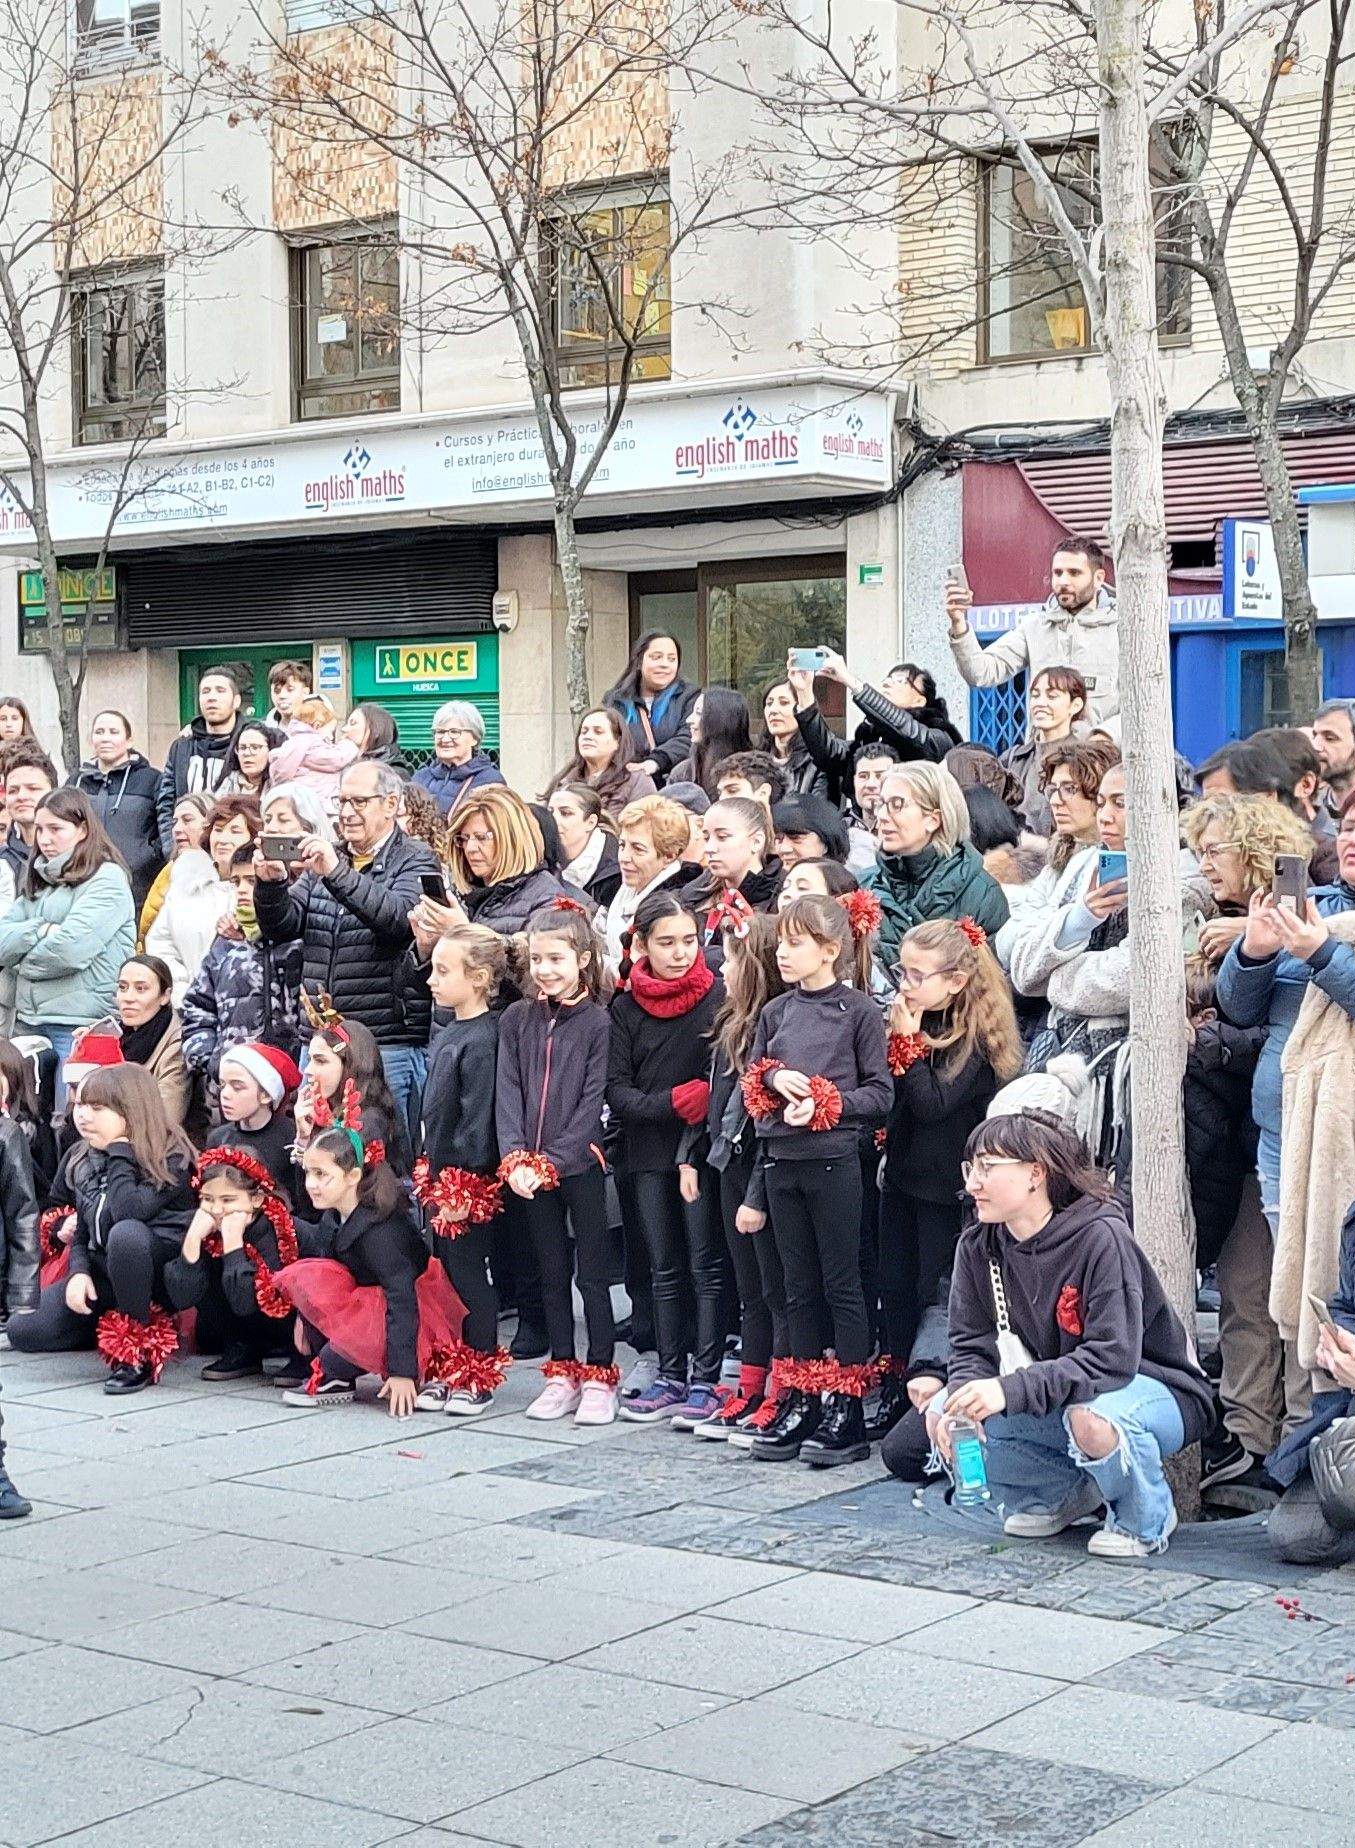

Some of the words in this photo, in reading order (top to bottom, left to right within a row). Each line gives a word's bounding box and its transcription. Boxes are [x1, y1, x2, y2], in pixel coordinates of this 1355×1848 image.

[444, 433, 483, 448] Cursos
[487, 435, 494, 446] y
[497, 427, 545, 443] Práctic
[822, 433, 854, 460] english
[858, 438, 884, 458] maths
[444, 456, 454, 468] el
[457, 452, 515, 468] extranjero
[613, 437, 636, 451] año
[676, 435, 735, 478] english
[745, 430, 798, 461] maths
[191, 462, 221, 476] desde
[224, 460, 239, 472] los
[242, 458, 248, 469] 4
[251, 456, 275, 470] años
[205, 478, 237, 492] B1-B2,
[241, 474, 275, 489] C1-C2)
[305, 474, 354, 512] english
[361, 469, 405, 498] maths
[406, 649, 469, 673] ONCE
[413, 683, 440, 692] HUESCA
